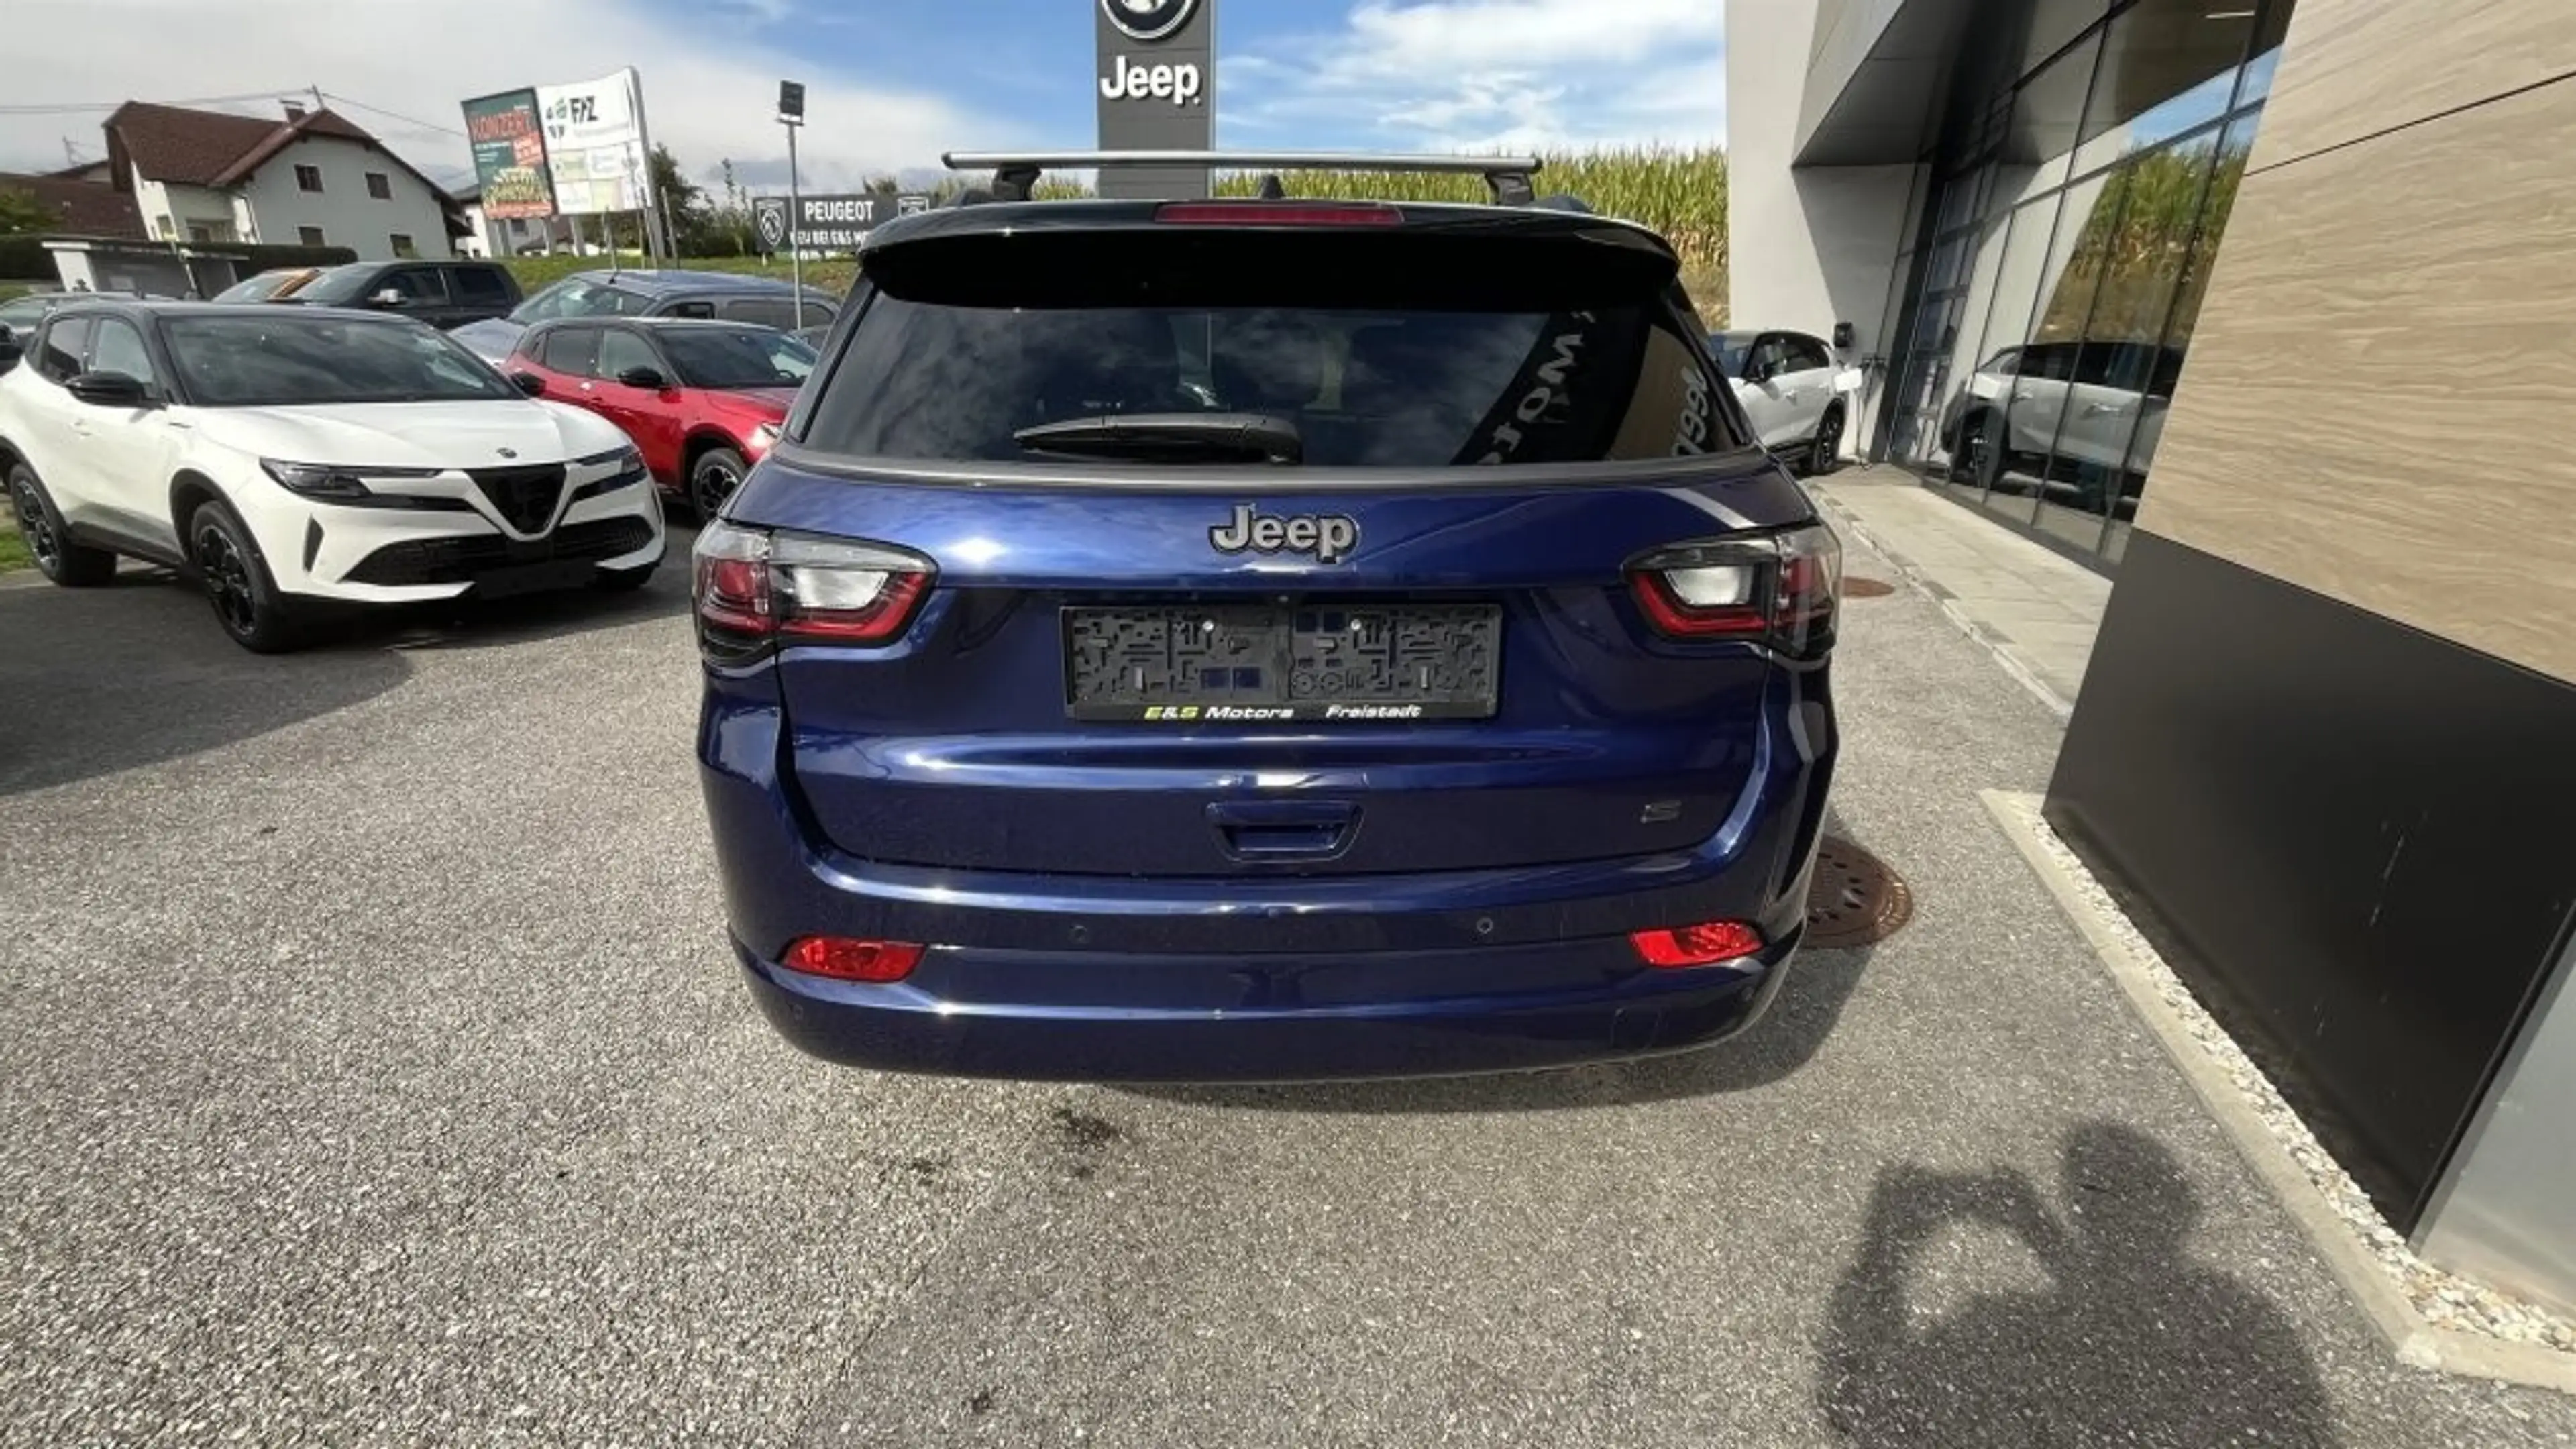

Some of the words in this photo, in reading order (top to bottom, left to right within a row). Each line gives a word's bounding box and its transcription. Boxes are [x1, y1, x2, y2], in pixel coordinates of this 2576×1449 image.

[805, 201, 874, 221] PEUGEOT
[1210, 503, 1358, 564] Jeep
[1144, 706, 1199, 720] E&S
[1205, 706, 1294, 720] Motors
[1326, 704, 1422, 719] Freistadt
